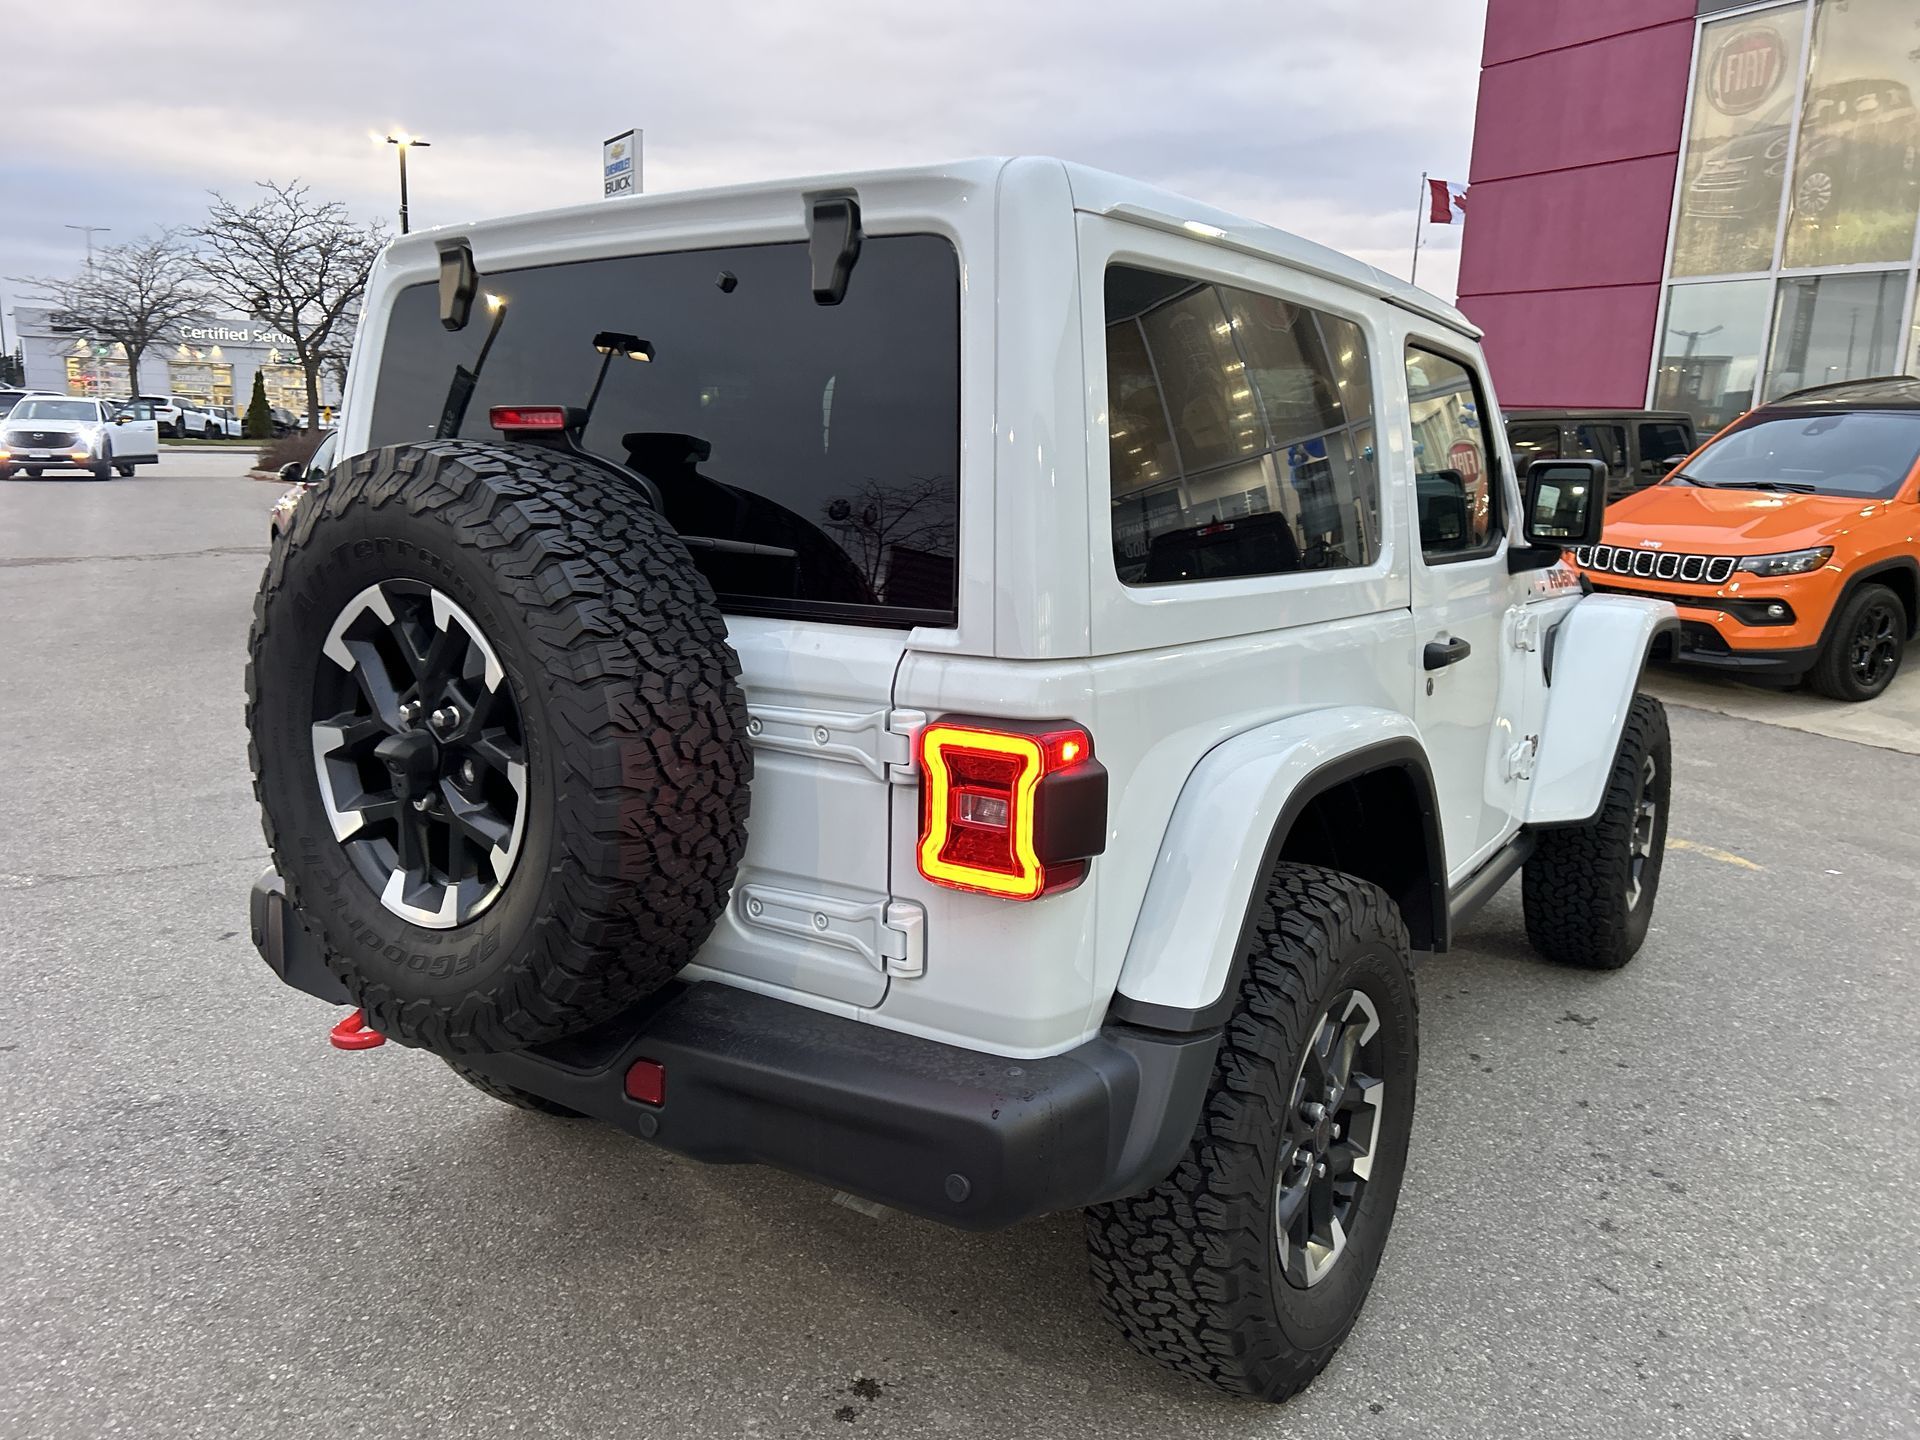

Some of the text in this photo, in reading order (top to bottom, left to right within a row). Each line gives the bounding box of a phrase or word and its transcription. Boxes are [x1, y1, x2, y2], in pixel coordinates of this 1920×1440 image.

[1724, 47, 1772, 93] FIAT
[605, 175, 631, 195] BUICK
[180, 325, 249, 342] Certified
[1640, 539, 1663, 549] Jeep
